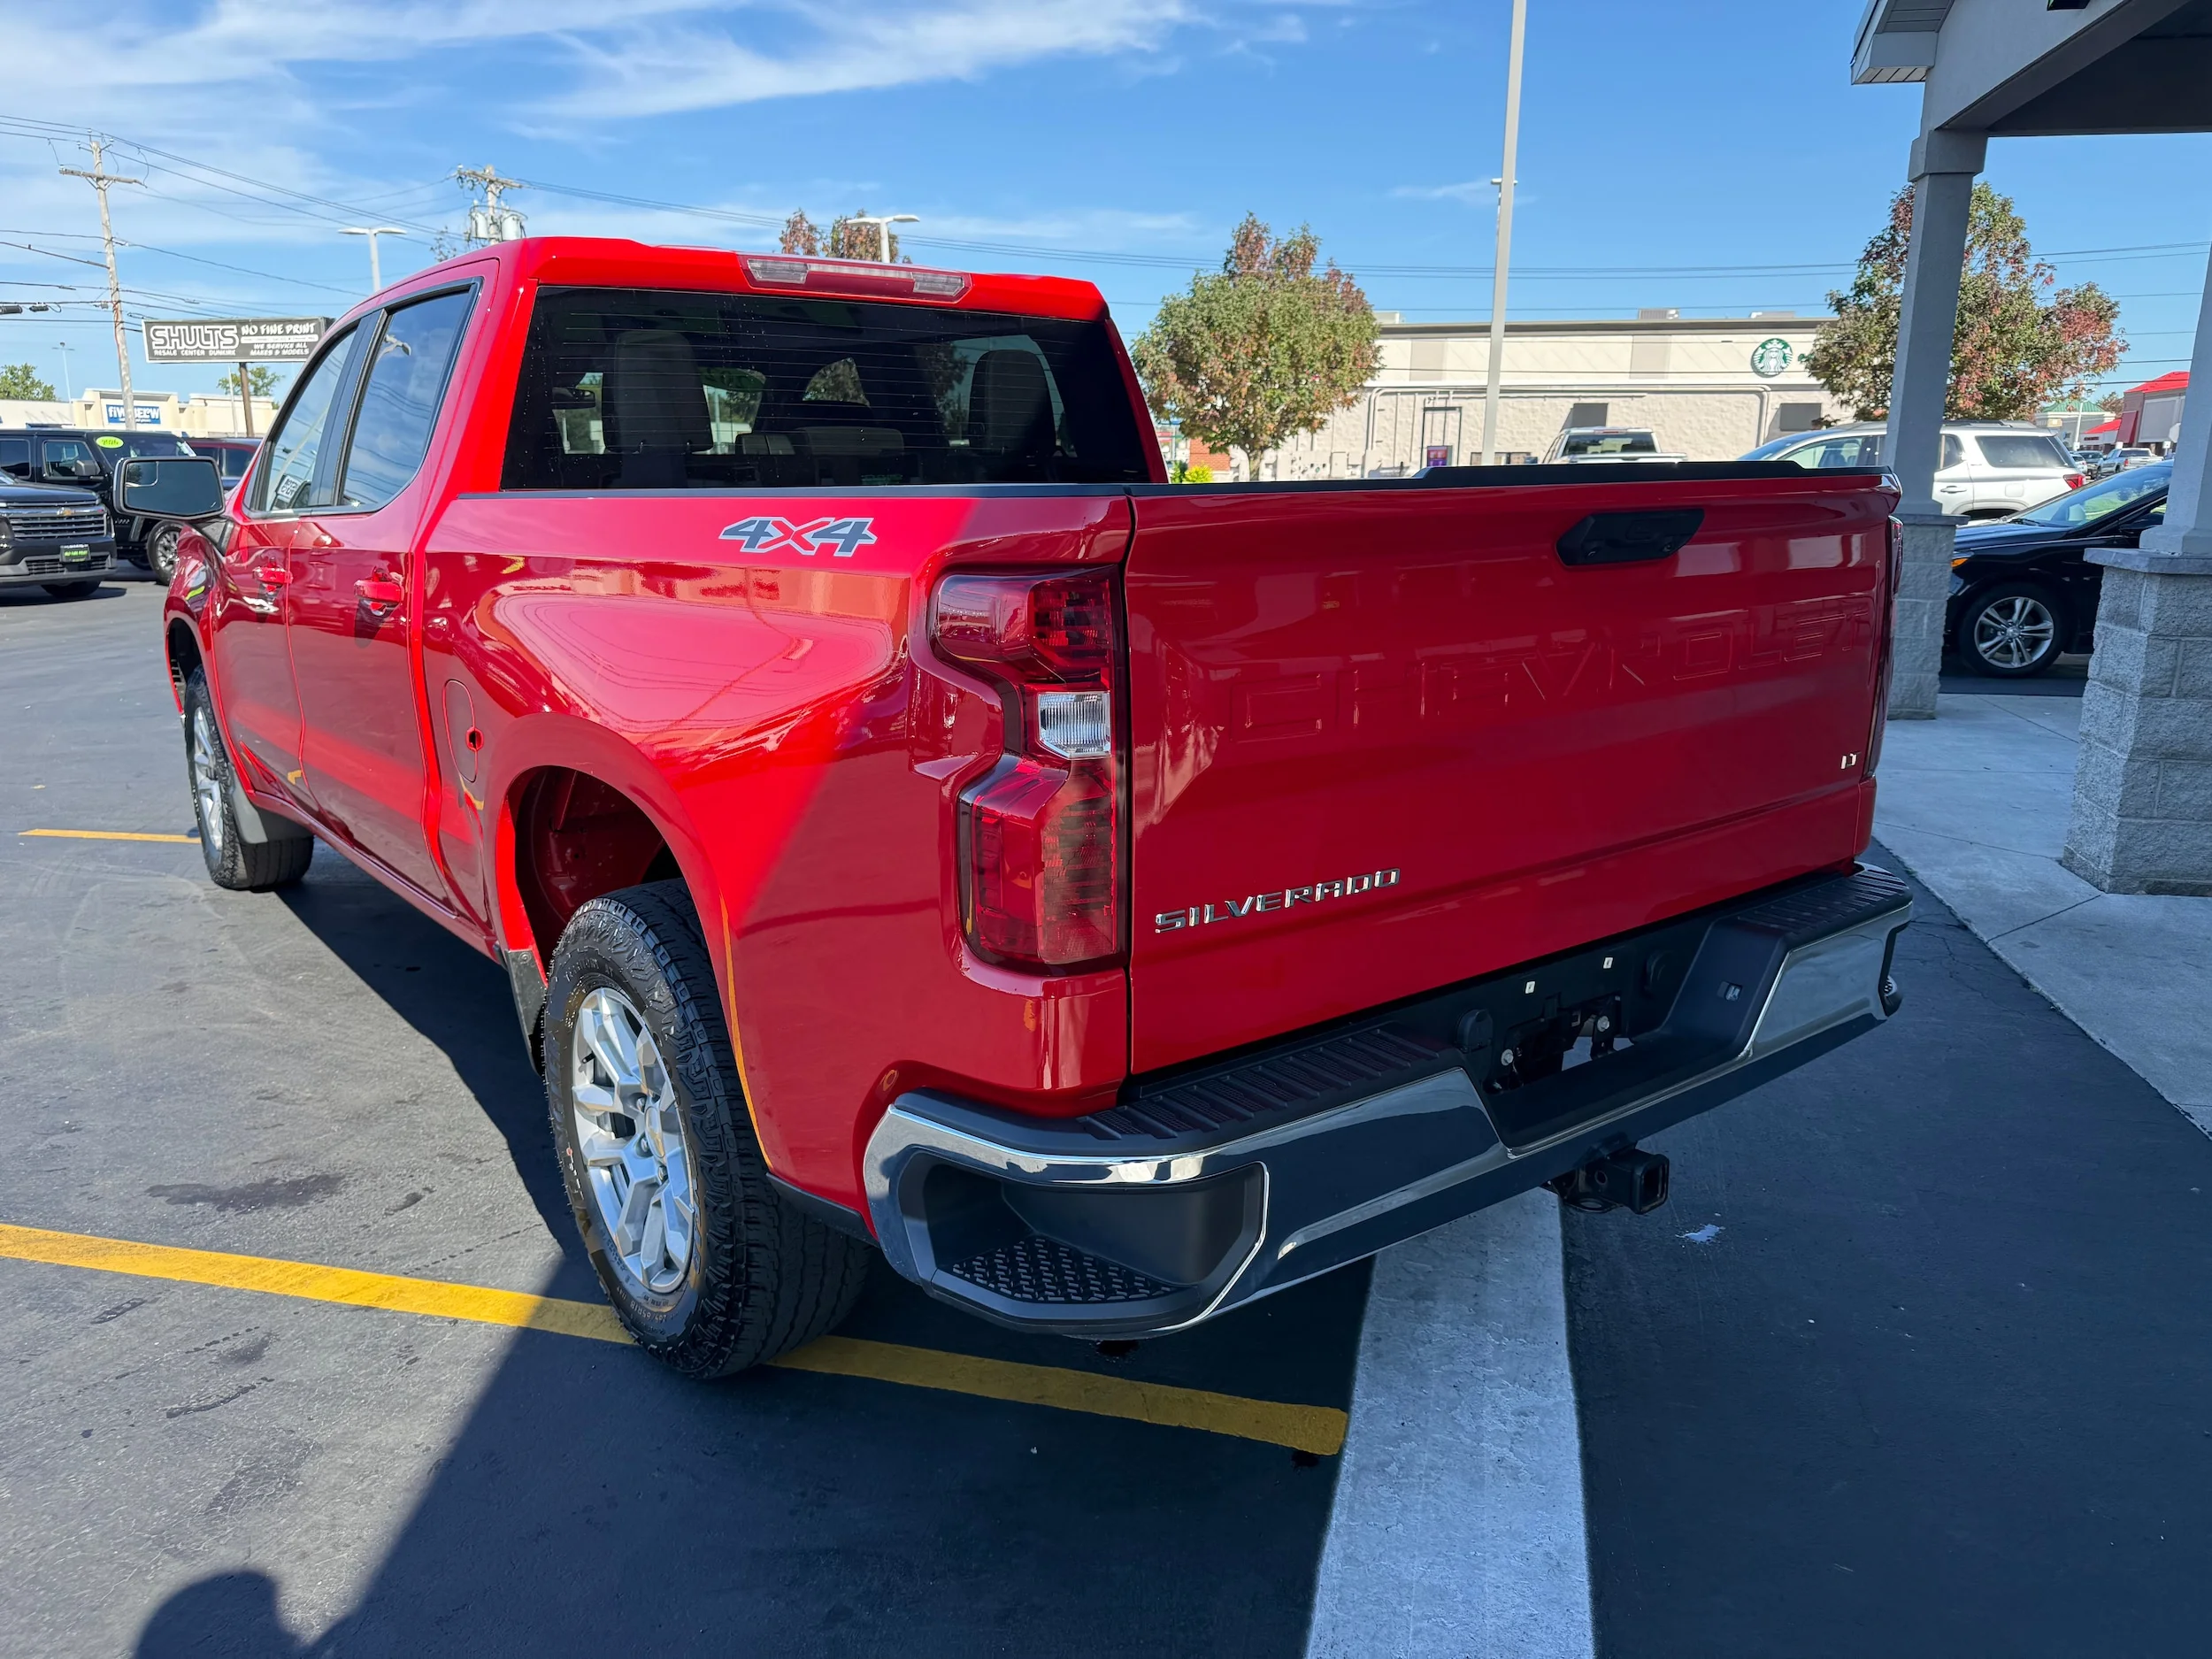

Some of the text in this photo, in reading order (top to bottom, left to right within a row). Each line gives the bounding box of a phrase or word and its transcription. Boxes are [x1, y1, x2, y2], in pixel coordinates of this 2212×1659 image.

[150, 325, 240, 349] SHULTS
[241, 322, 316, 335] NO FINE PRINT
[1230, 603, 1870, 742] CHEVROLET
[1840, 752, 1862, 770] LT
[1155, 868, 1401, 933] SILVERADO
